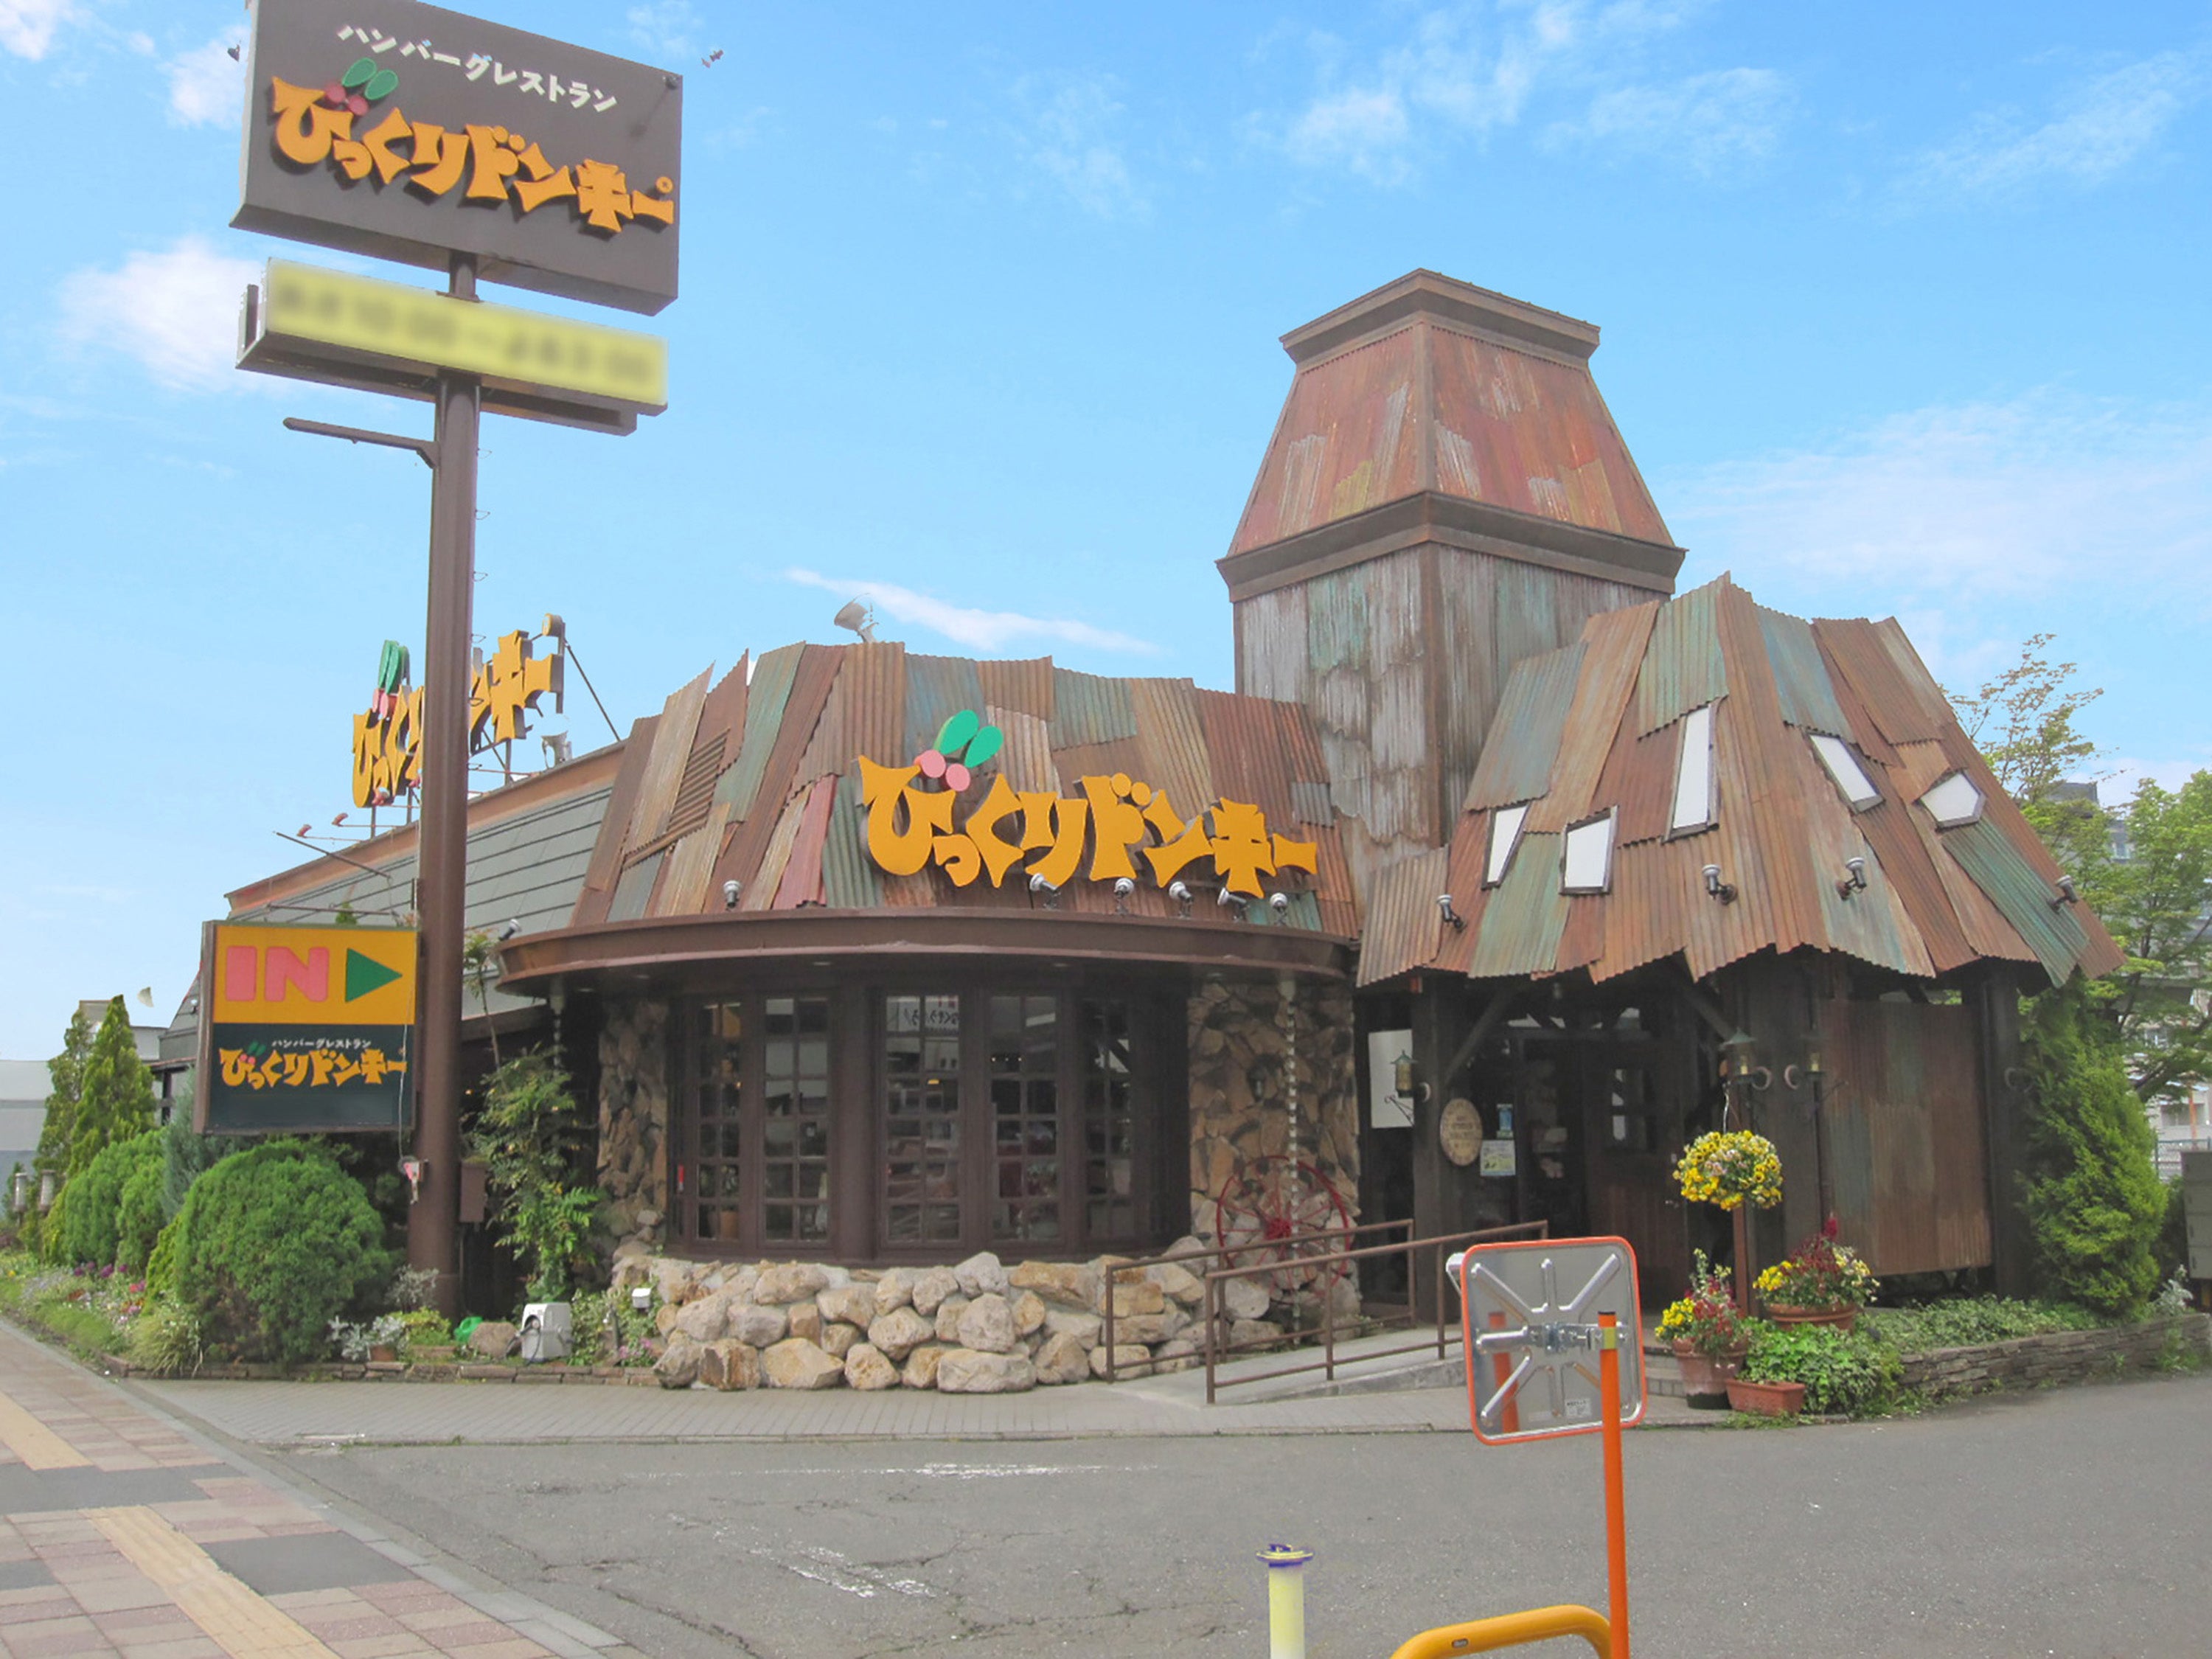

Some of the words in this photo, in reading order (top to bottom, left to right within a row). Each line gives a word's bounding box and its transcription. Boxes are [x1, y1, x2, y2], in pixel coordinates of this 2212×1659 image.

[336, 24, 618, 113] ハンバーグレストラン
[271, 76, 675, 232] びっくりドンキー
[858, 754, 1318, 898] びっくりドンキー
[225, 945, 330, 1002] IN
[219, 1047, 408, 1090] びっくりドンキー
[271, 1037, 371, 1049] ハンバーグレストラン
